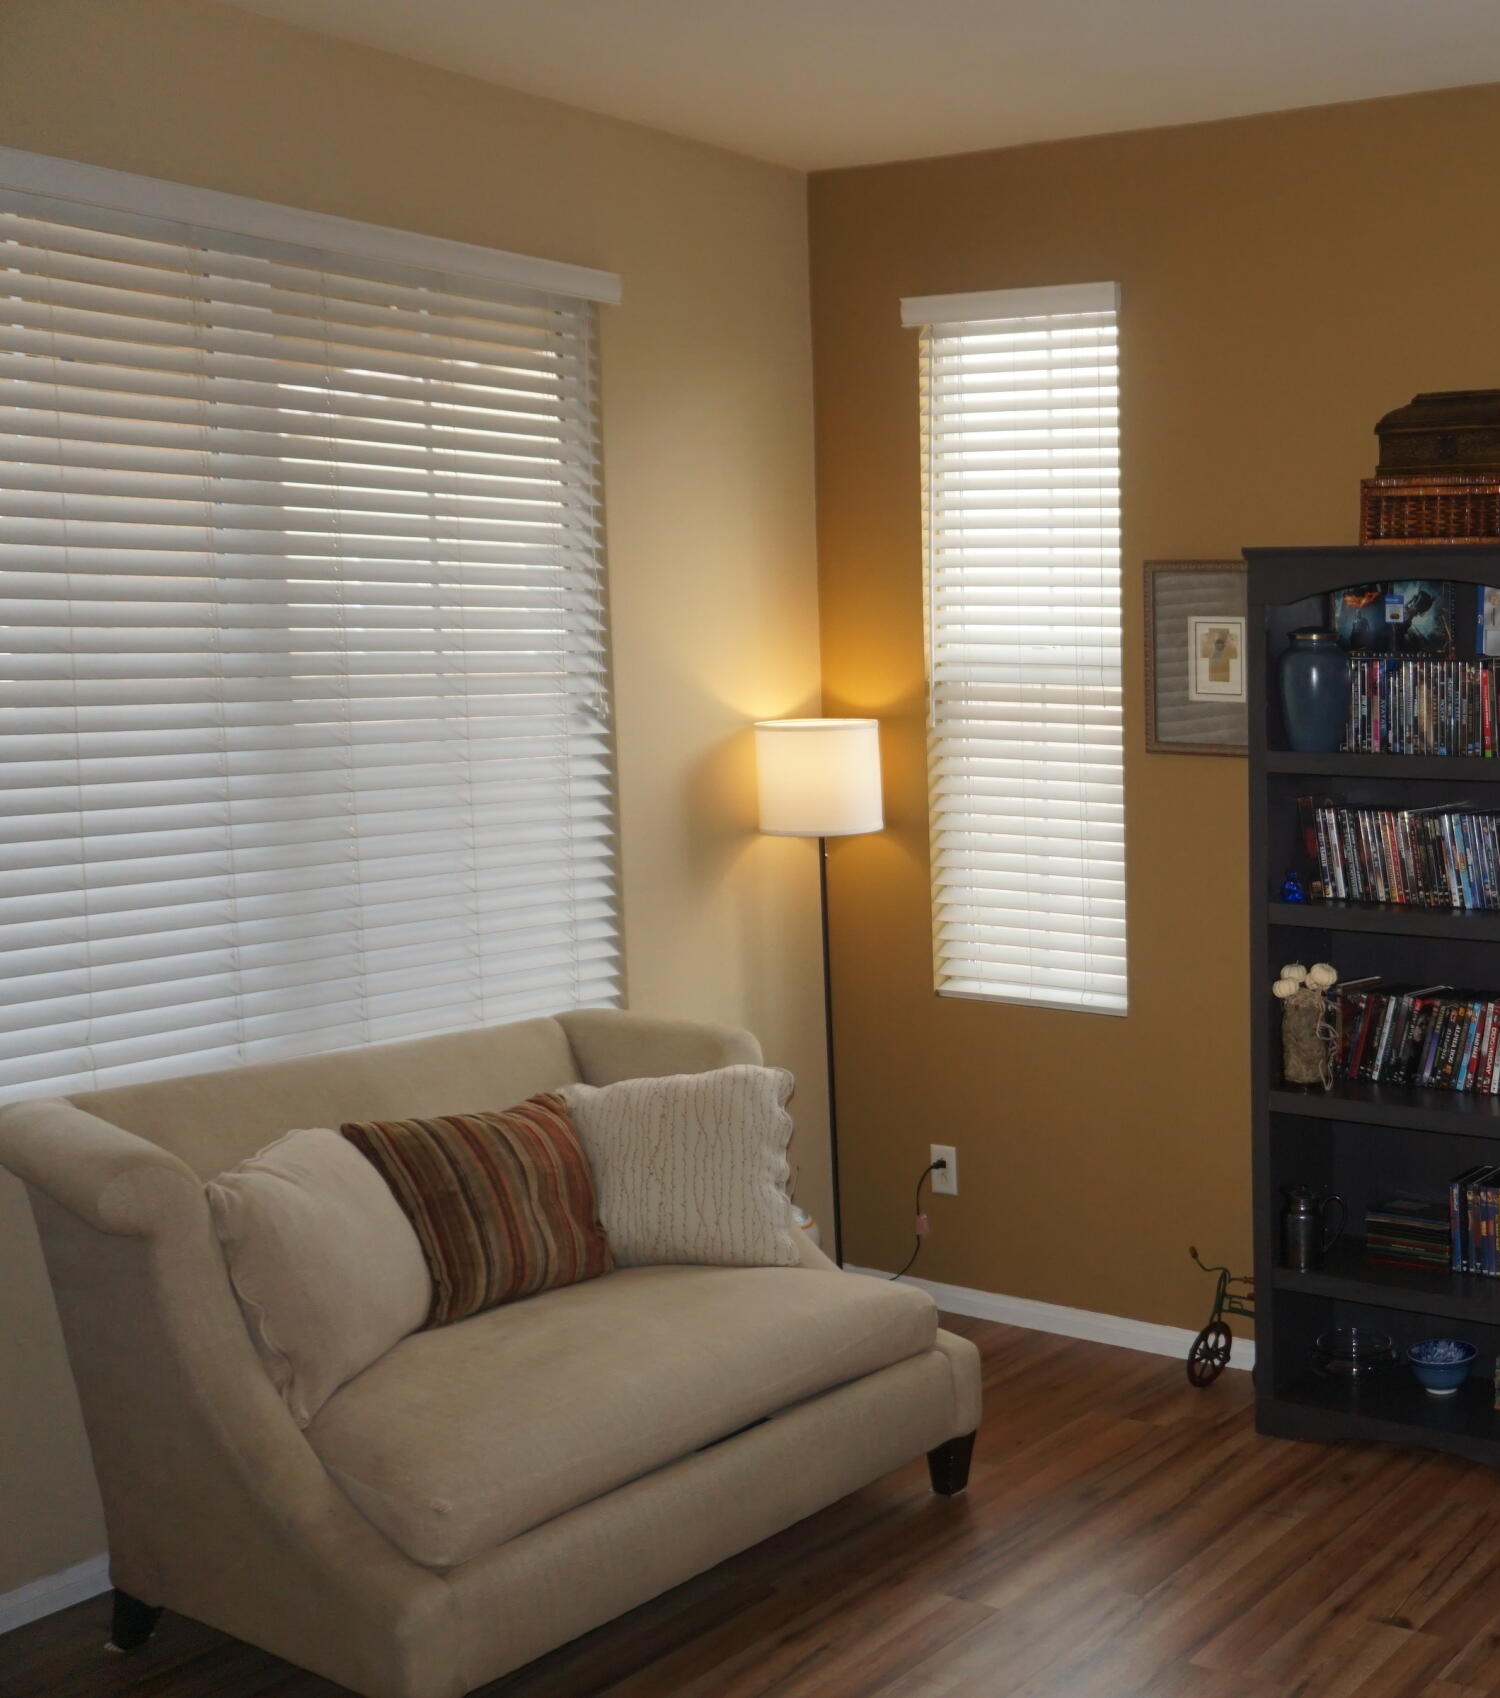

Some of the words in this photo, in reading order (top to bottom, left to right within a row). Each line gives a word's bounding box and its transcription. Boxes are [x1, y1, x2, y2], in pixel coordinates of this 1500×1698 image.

[1450, 1024, 1462, 1049] ALPHA
[1448, 1049, 1457, 1064] DOG
[1486, 1026, 1498, 1075] DOOMSDAY
